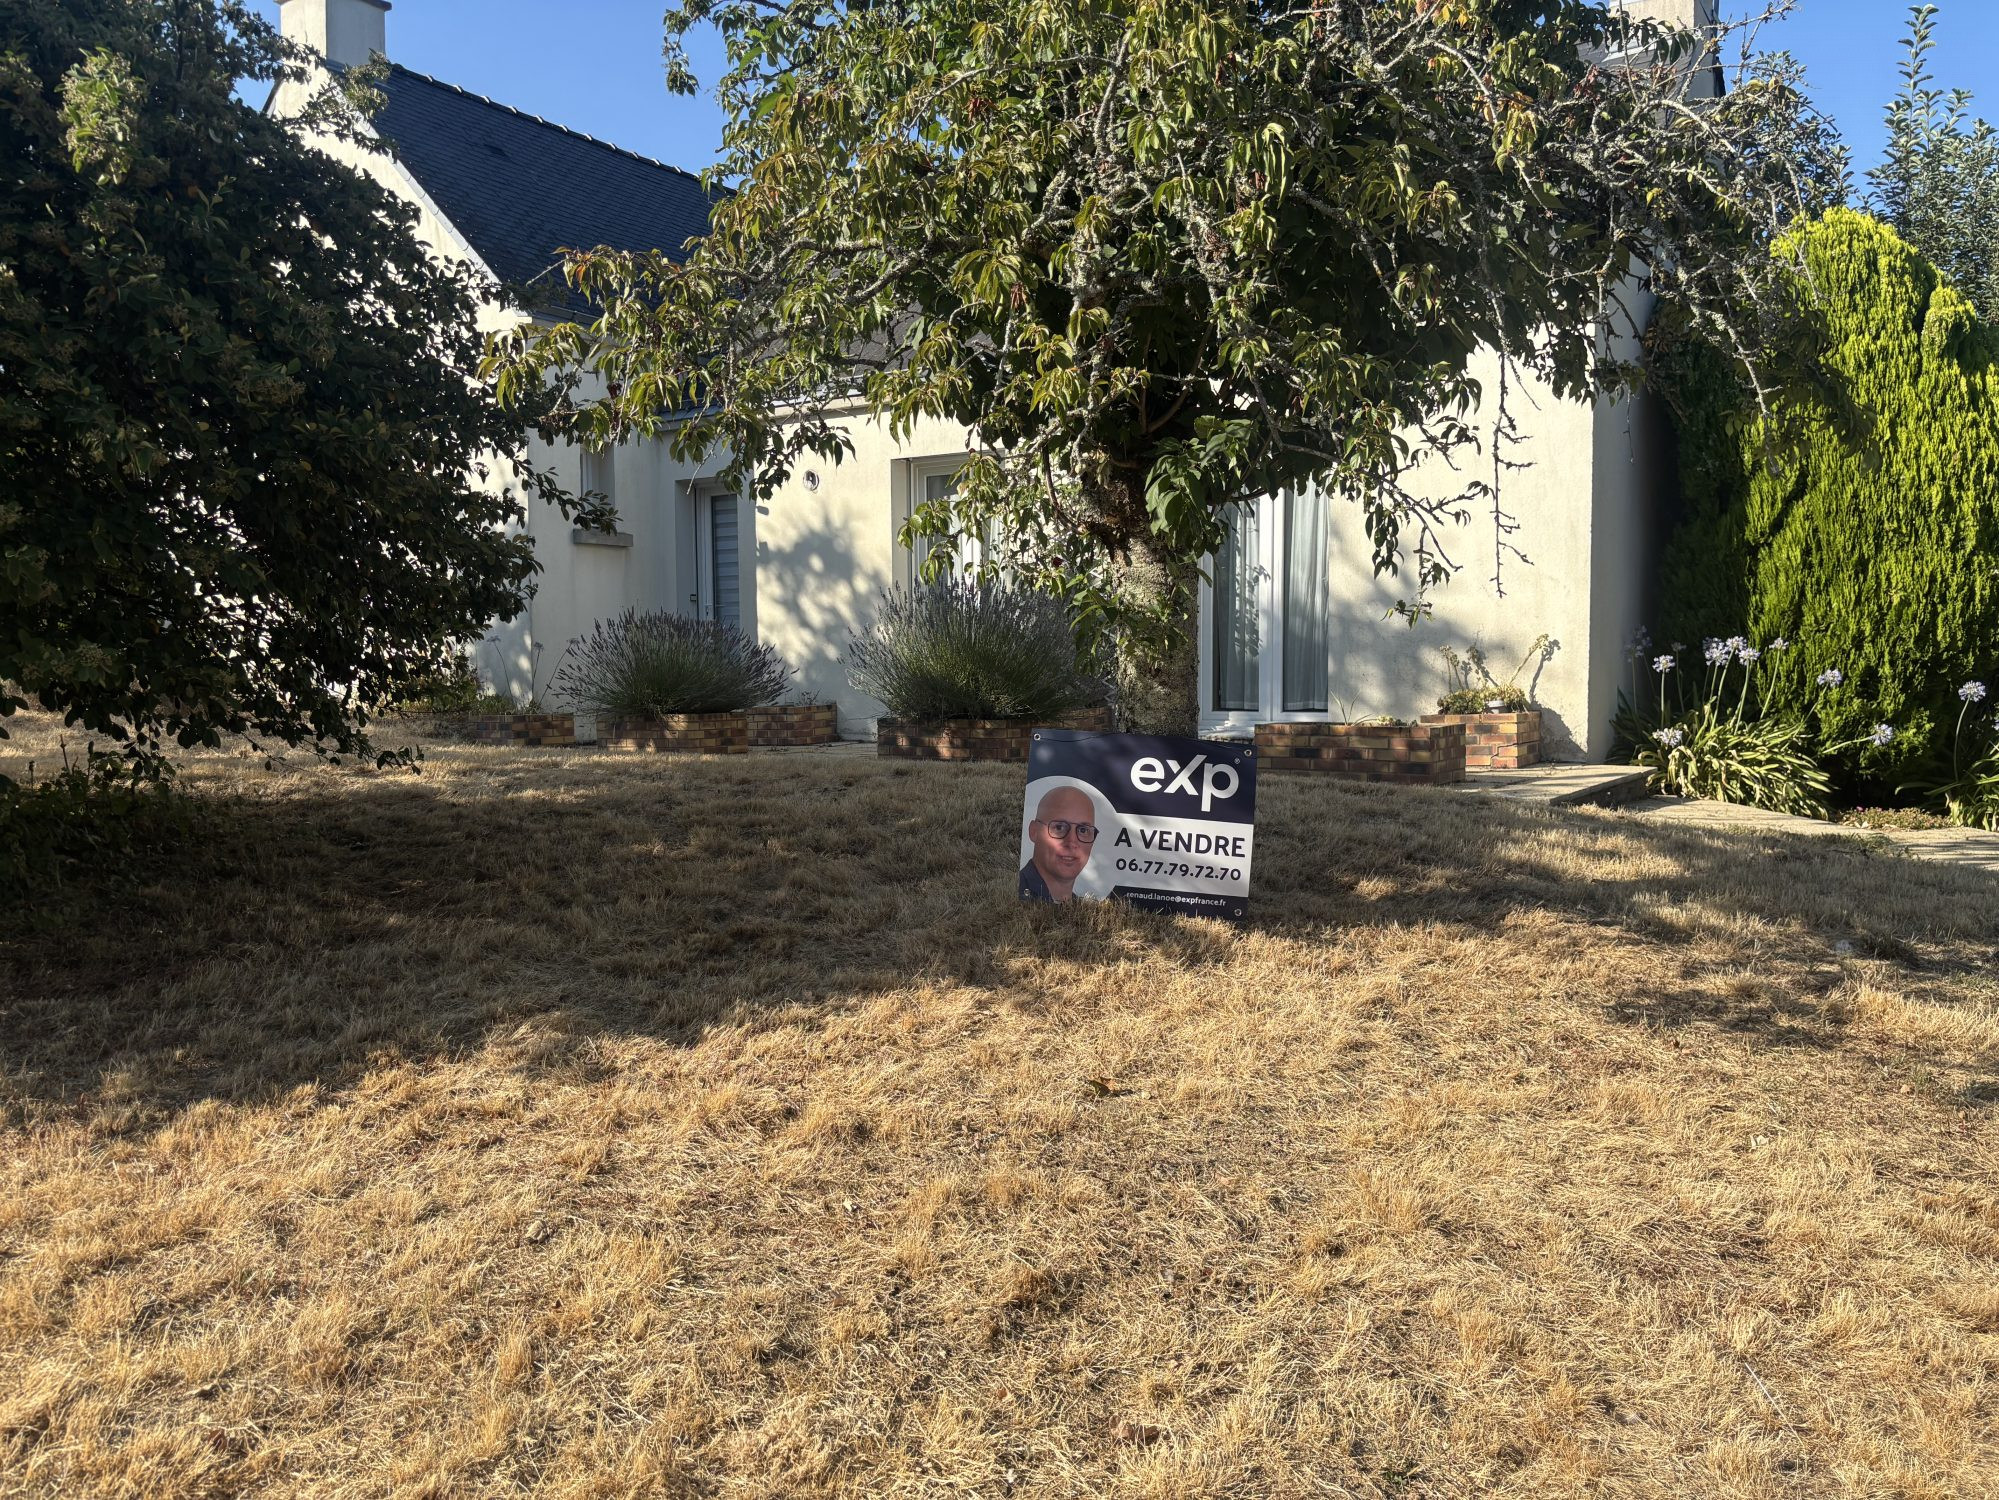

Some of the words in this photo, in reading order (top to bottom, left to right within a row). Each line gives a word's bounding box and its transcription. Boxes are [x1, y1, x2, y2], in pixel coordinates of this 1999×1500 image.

[1114, 827, 1132, 847] A
[1139, 829, 1246, 858] VENDRE
[1115, 858, 1241, 881] 06.77.79.72.70
[1126, 891, 1227, 907] renaud.lanoe@expfrance.fr
